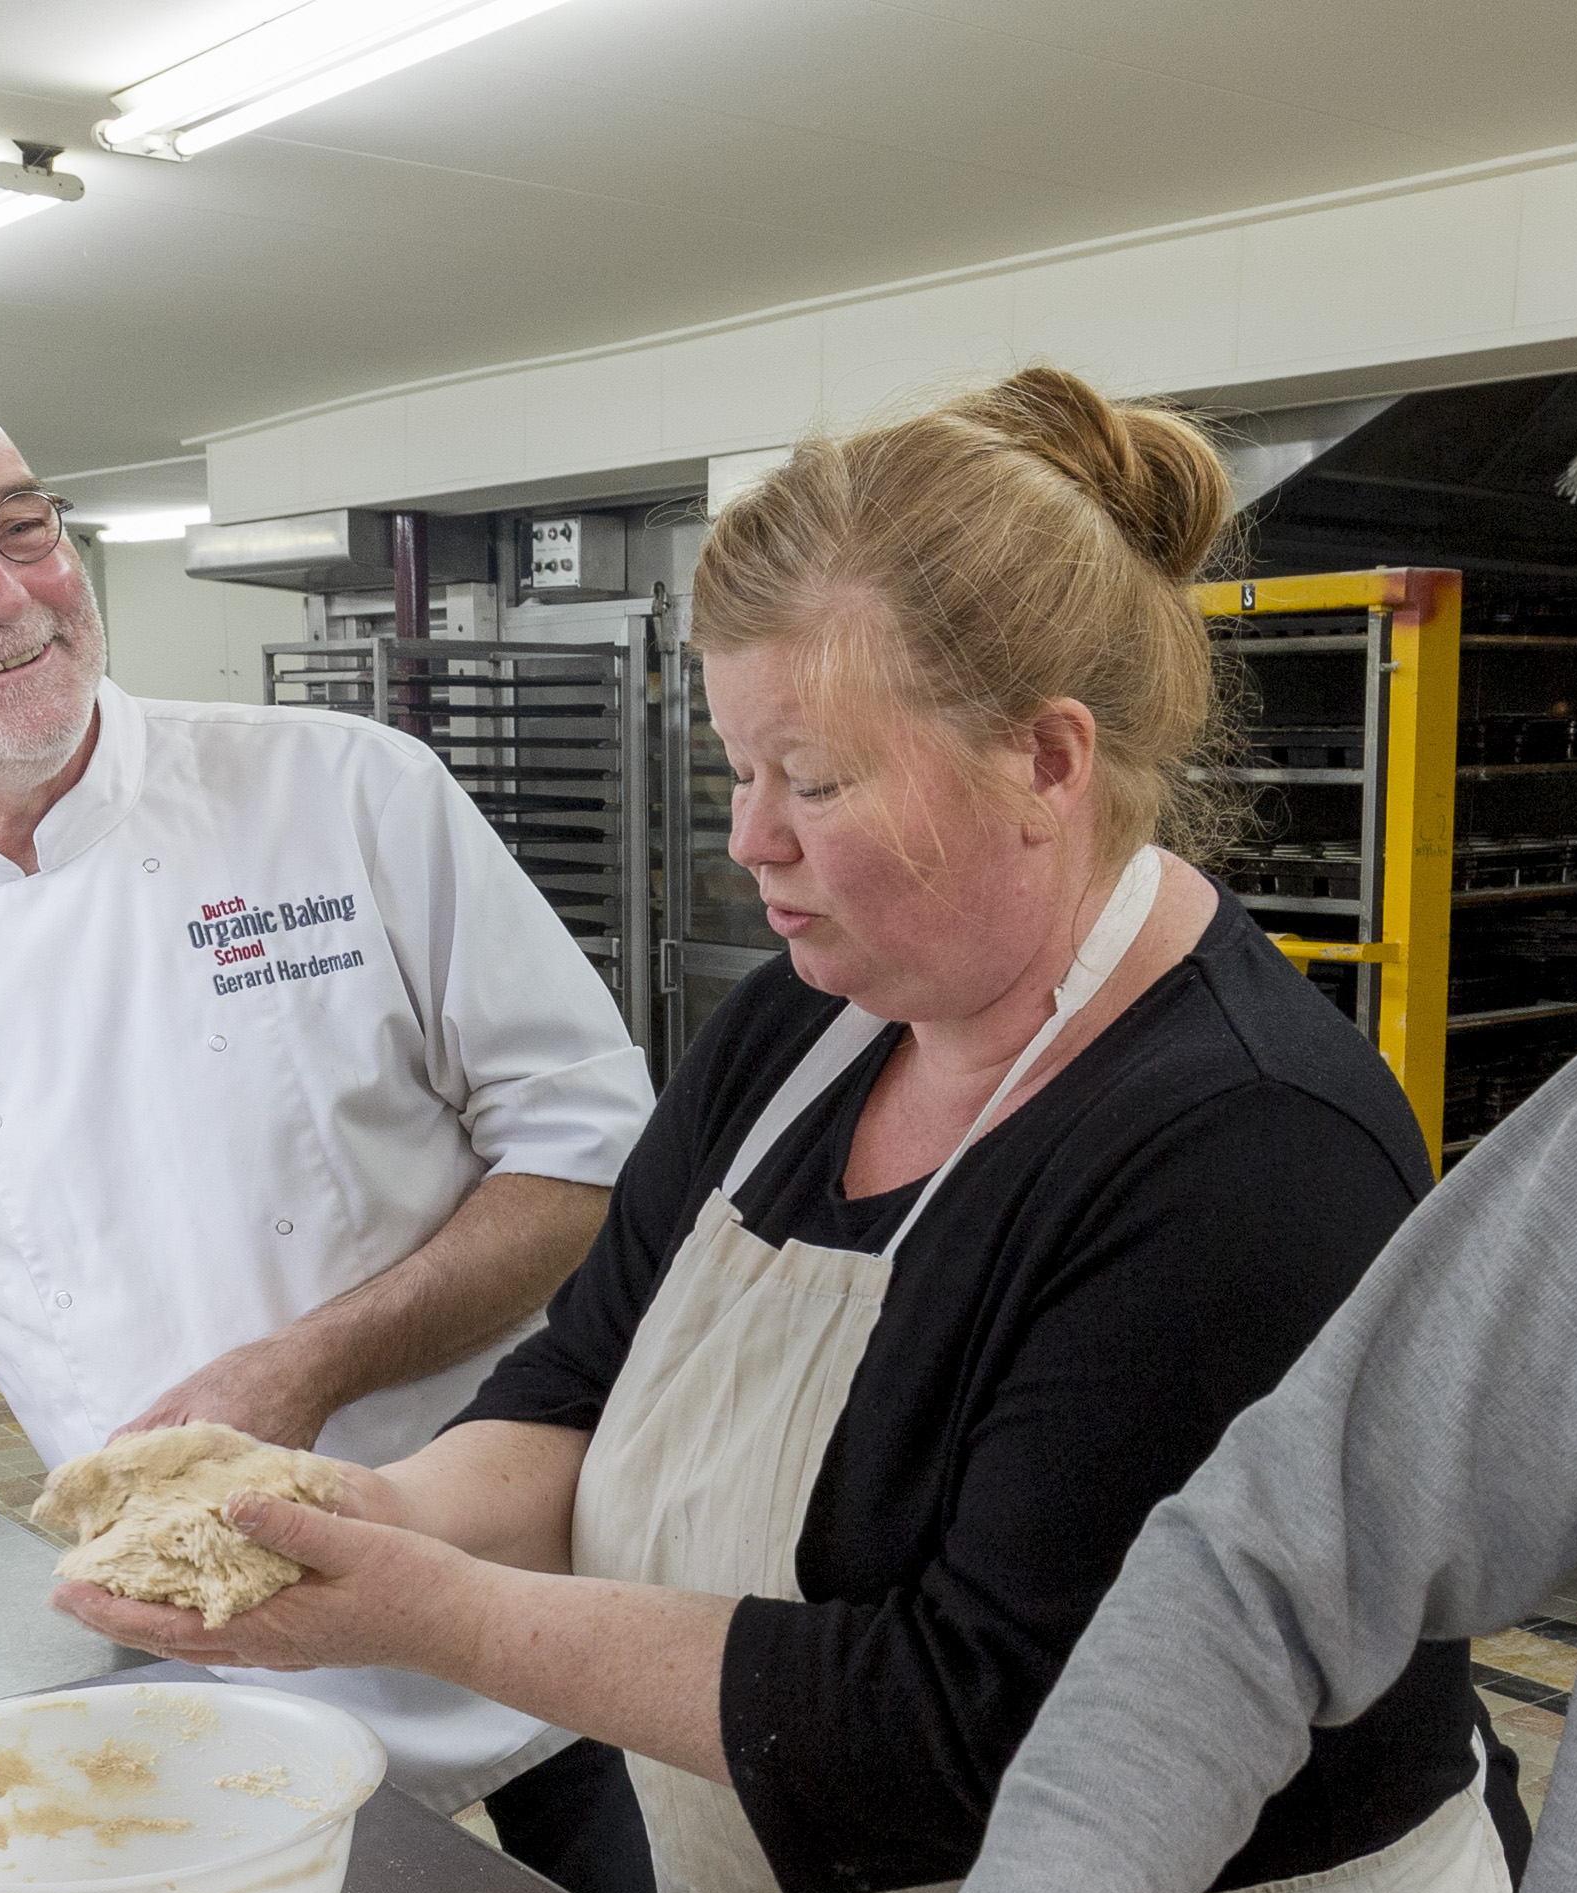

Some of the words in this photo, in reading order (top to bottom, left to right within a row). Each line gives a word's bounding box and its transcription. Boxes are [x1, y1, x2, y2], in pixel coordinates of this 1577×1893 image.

[187, 906, 278, 949] Organic
[278, 894, 357, 932] Baking
[201, 896, 247, 921] Dutch
[214, 939, 266, 966] School
[212, 962, 275, 996] Gerard
[276, 949, 364, 983] Hardeman
